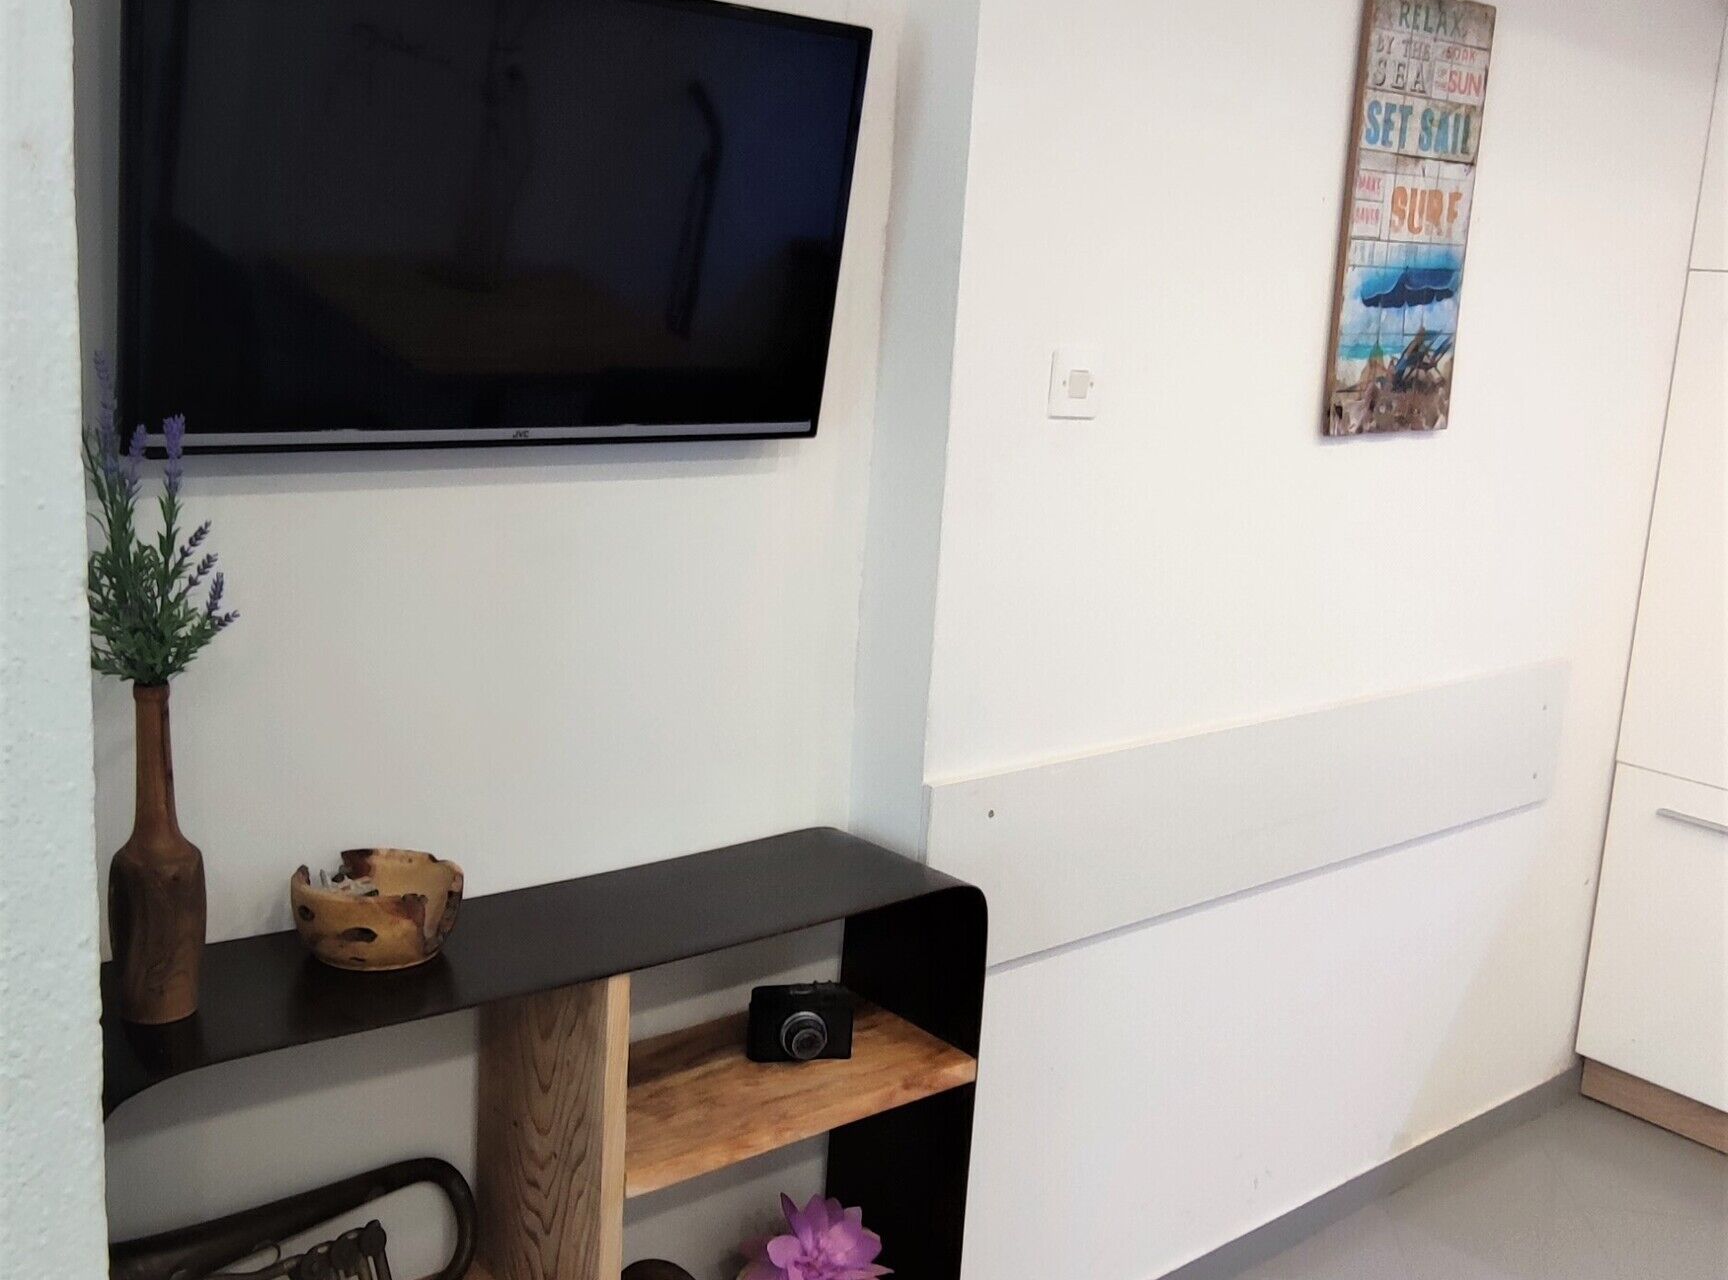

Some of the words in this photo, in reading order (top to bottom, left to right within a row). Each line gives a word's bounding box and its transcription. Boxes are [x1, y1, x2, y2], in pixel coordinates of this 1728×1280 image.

[1376, 36, 1395, 55] BY
[1402, 39, 1431, 62] THE
[1373, 60, 1427, 94] SEA
[1447, 69, 1483, 97] SUN
[1365, 100, 1414, 150] SET
[1418, 107, 1471, 156] SAIL
[1391, 185, 1463, 238] SURF
[512, 429, 530, 439] JVC
